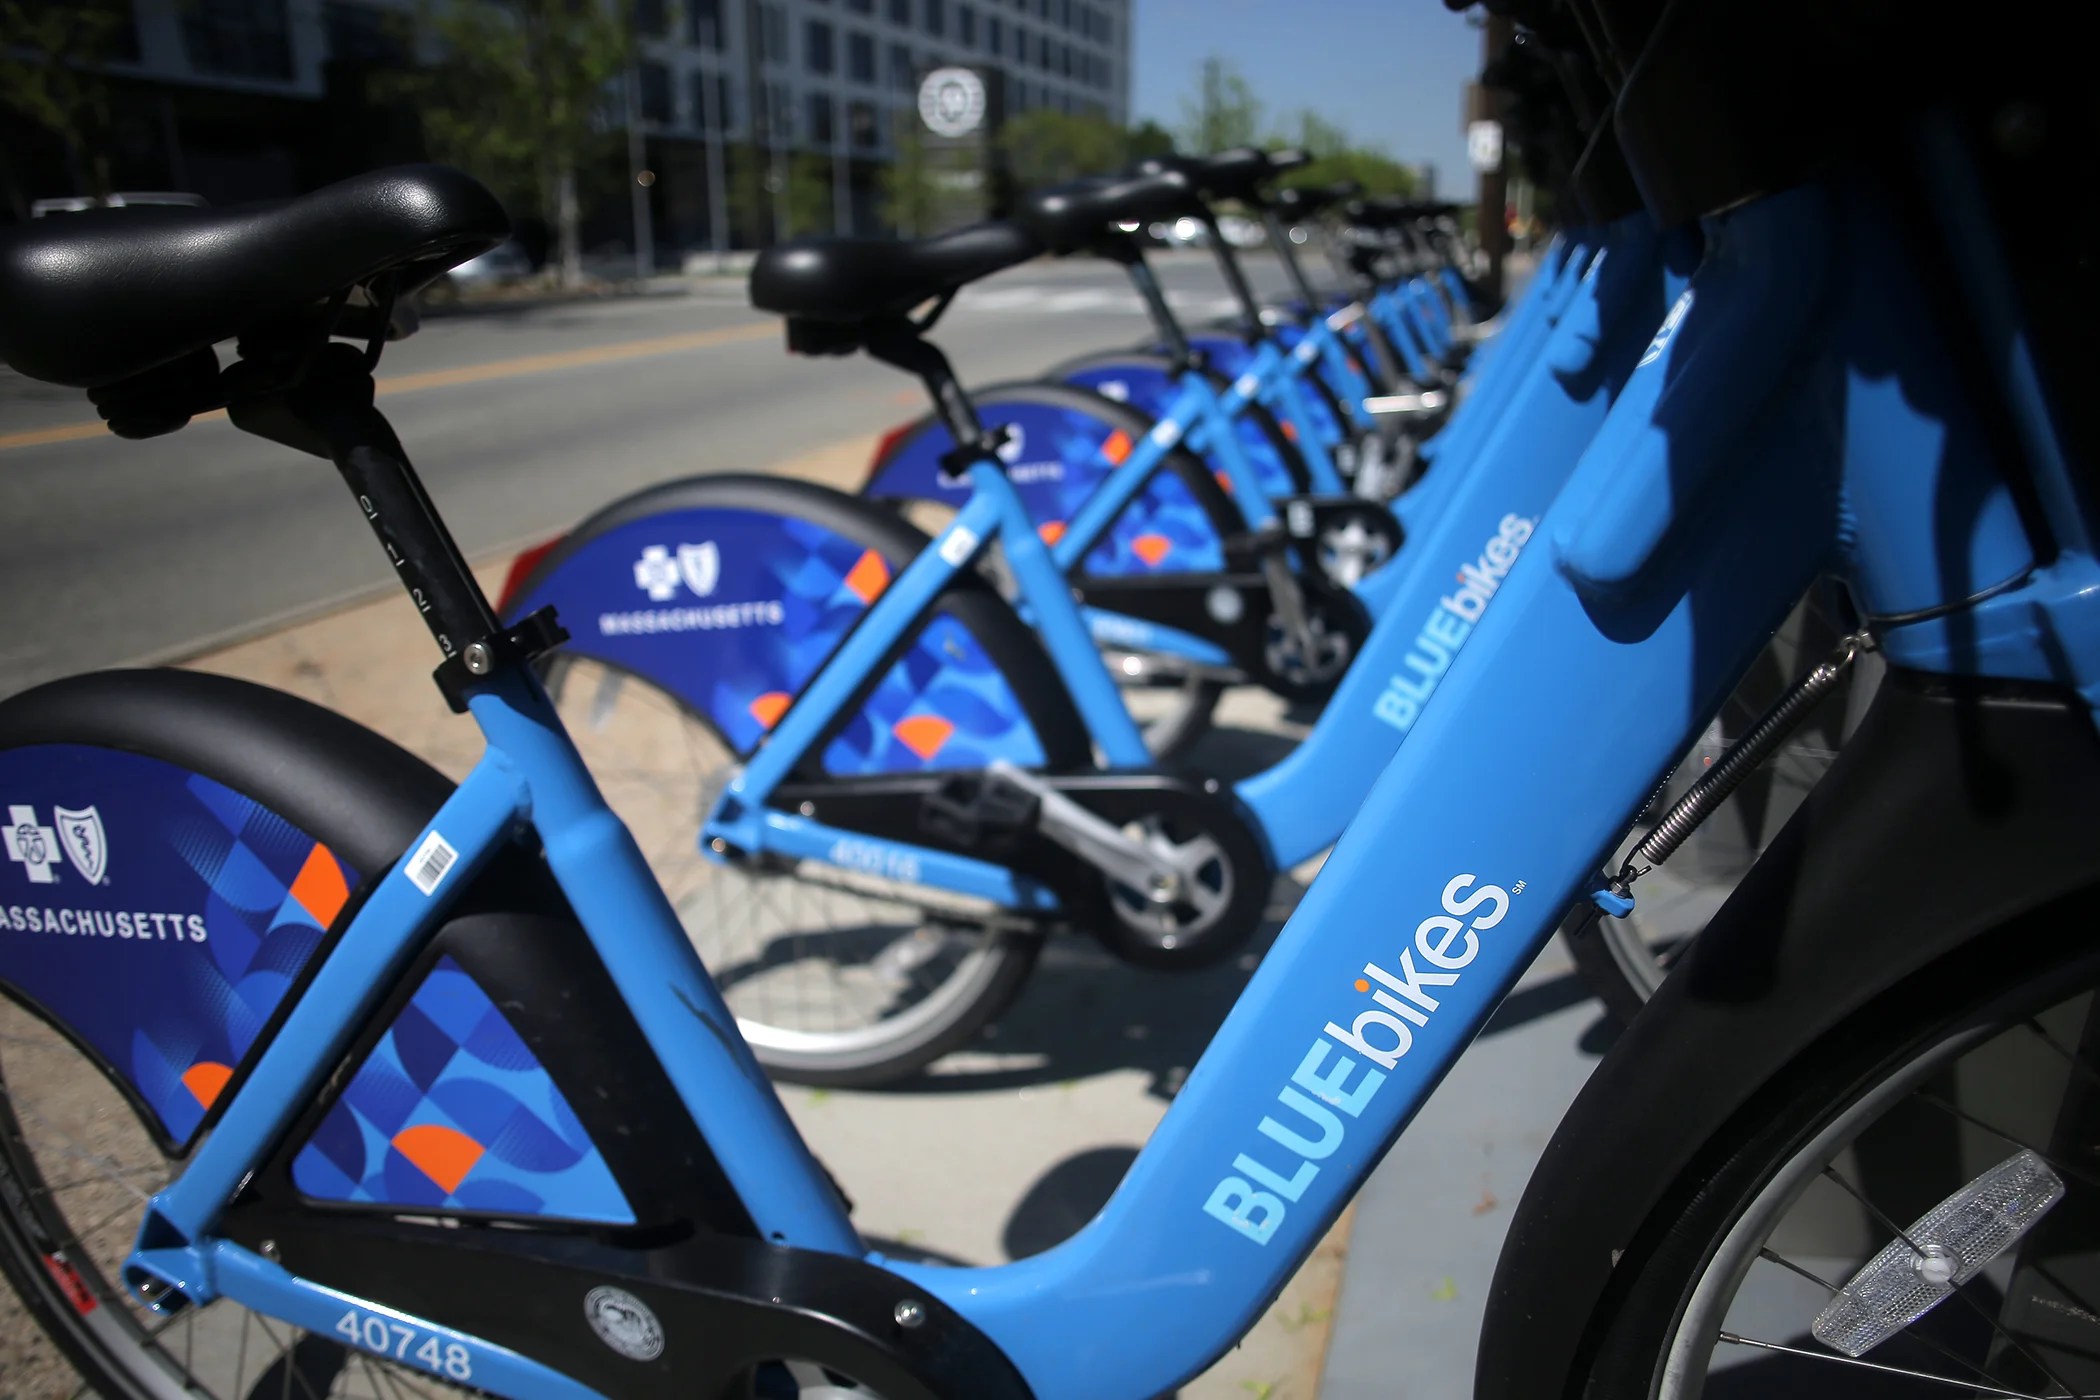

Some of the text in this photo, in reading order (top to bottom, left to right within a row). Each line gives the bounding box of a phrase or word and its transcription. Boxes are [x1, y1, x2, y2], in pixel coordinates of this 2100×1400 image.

[413, 588, 426, 606] 2
[1373, 513, 1534, 729] BLUEbikes
[438, 634, 452, 652] 3
[0, 905, 207, 942] ASSACHUSETTS
[1203, 873, 1527, 1247] BLUEbikes SM
[336, 1310, 472, 1381] 40748
